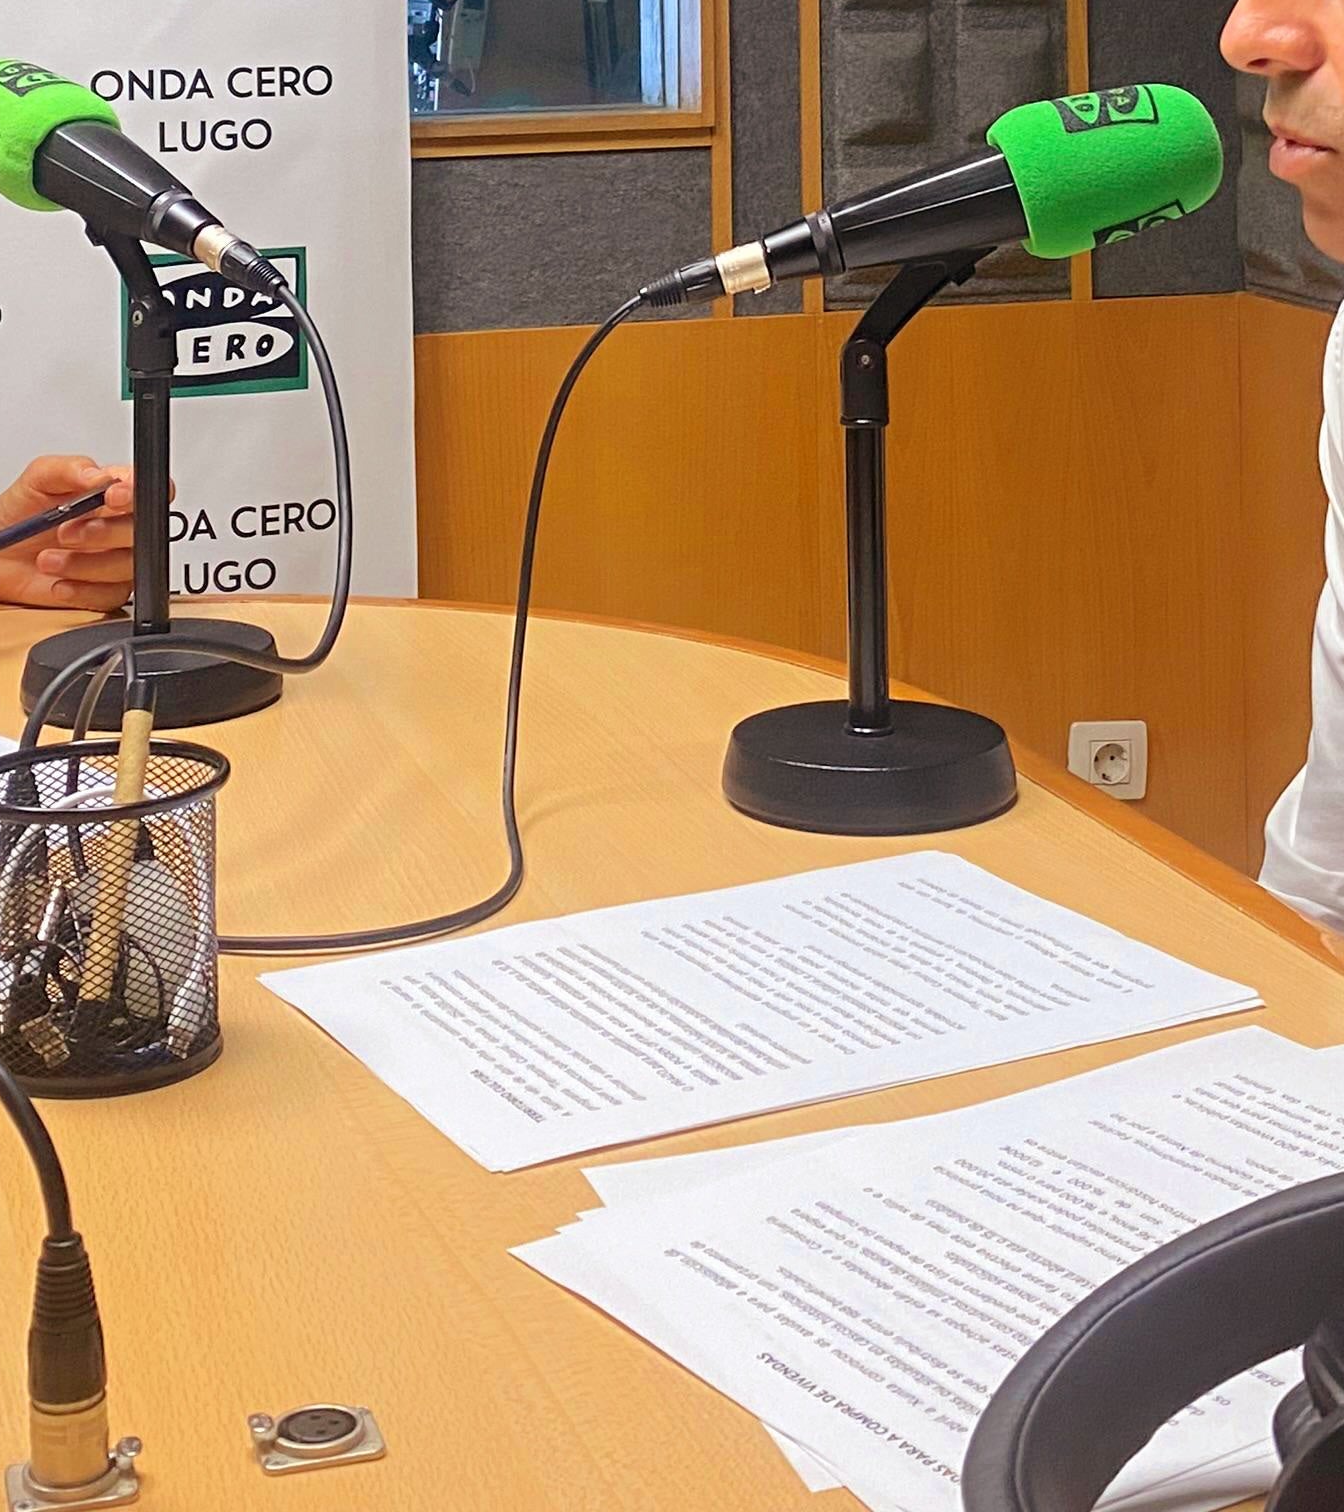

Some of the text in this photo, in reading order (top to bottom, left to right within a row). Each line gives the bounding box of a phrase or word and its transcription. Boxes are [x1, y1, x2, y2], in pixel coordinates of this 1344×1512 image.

[90, 68, 214, 102] ONDA
[227, 65, 333, 98] CERO
[159, 119, 272, 152] LUGO
[193, 334, 274, 364] ERO
[169, 498, 336, 542] DA CERO
[169, 558, 277, 595] UGO
[756, 1352, 817, 1392] VIVENDAS
[833, 1400, 889, 1434] COMPRA
[898, 1441, 937, 1465] PARA
[929, 1462, 964, 1483] DAS
